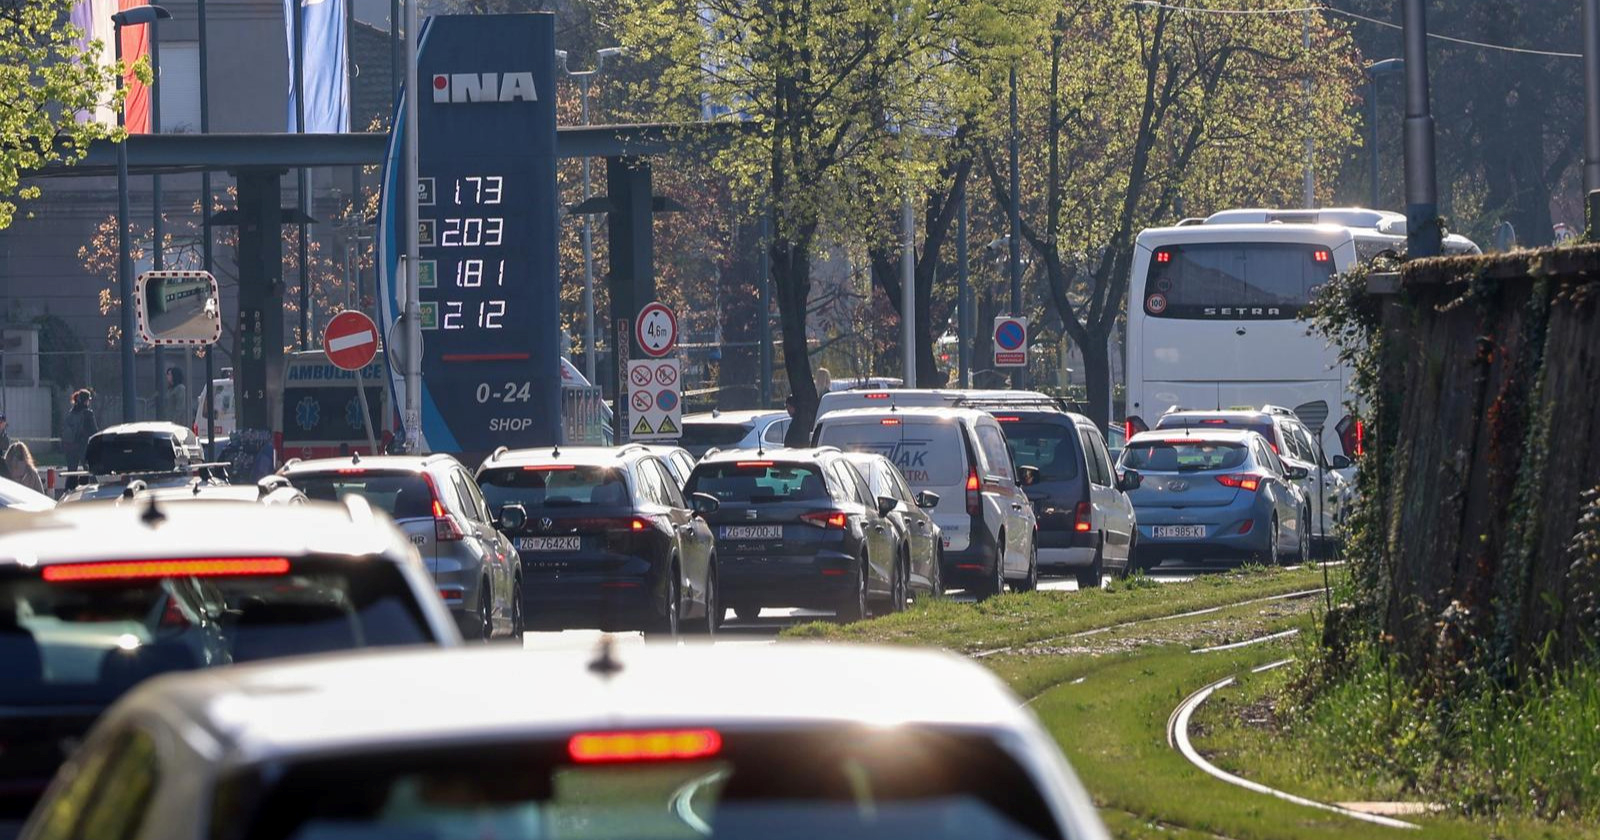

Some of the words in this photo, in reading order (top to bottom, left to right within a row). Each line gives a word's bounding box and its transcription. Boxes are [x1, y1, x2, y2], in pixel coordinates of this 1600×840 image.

[454, 176, 503, 205] 1.73
[442, 218, 504, 247] 2.03
[456, 259, 505, 288] 1.81
[1151, 299, 1163, 307] 100
[1203, 307, 1280, 316] SETRA
[444, 300, 506, 329] 2.12
[489, 418, 533, 431] SHOP
[409, 535, 425, 545] HR
